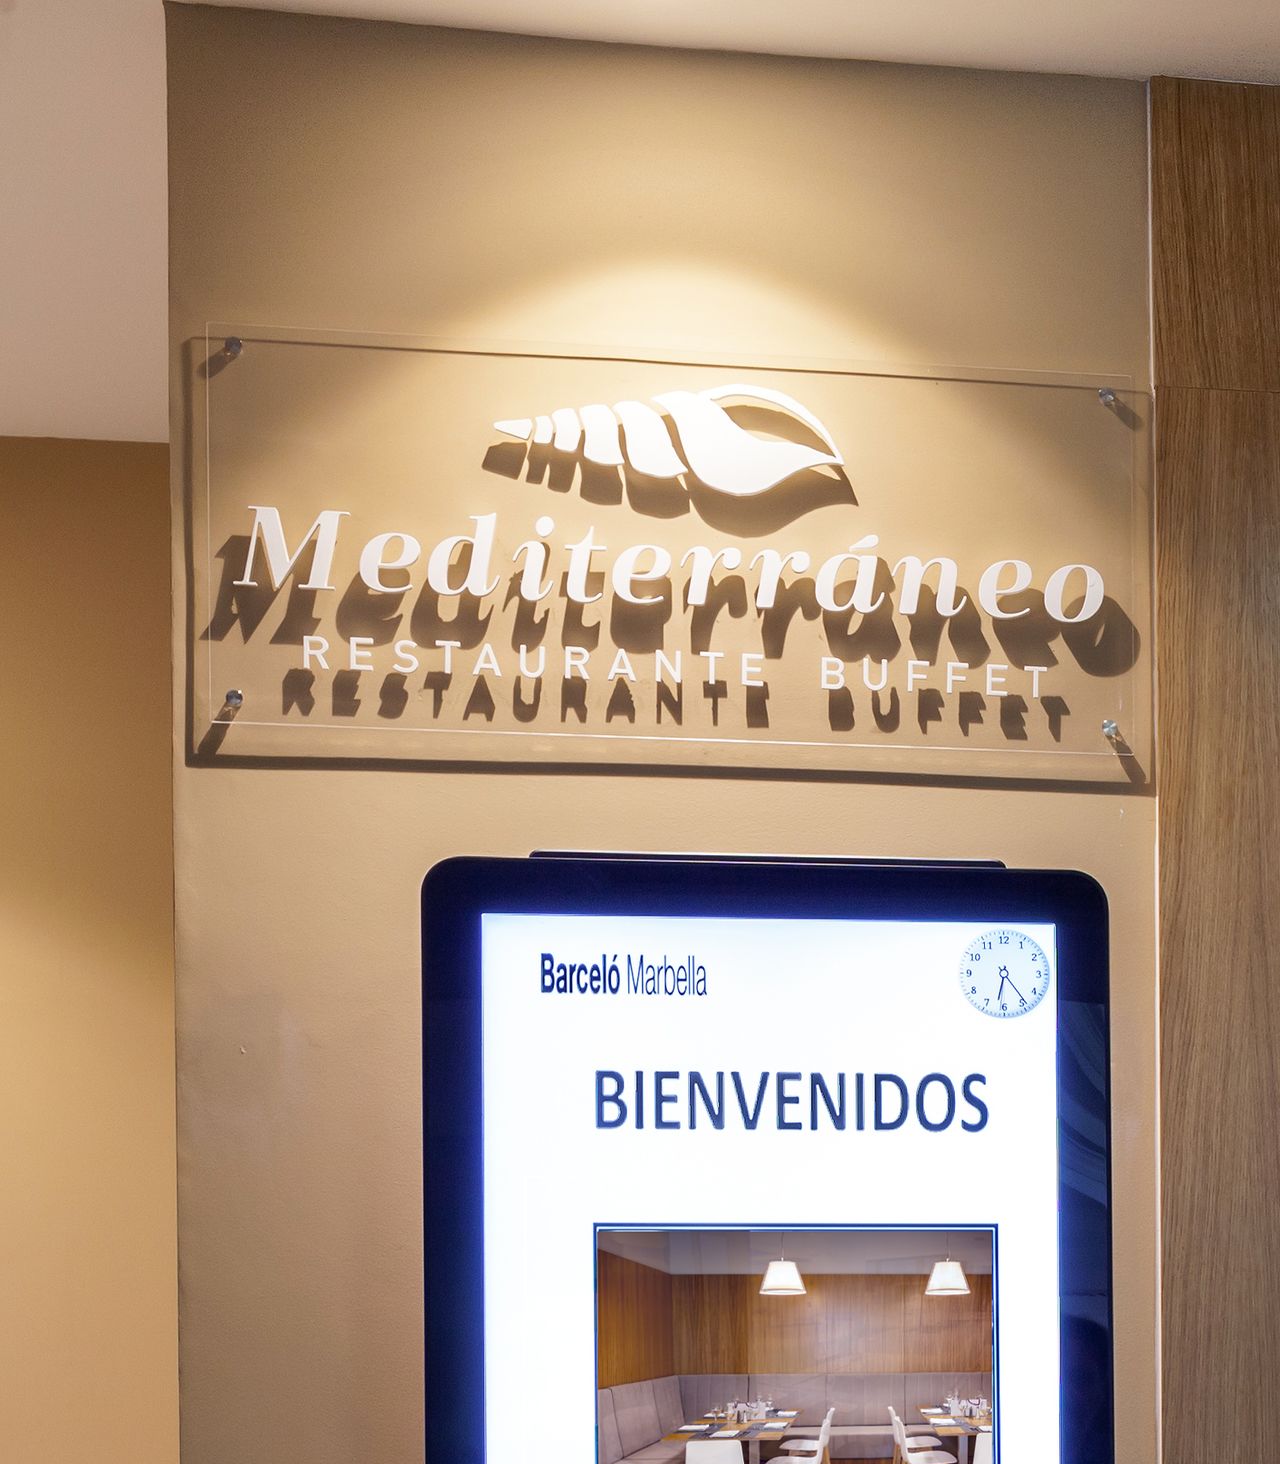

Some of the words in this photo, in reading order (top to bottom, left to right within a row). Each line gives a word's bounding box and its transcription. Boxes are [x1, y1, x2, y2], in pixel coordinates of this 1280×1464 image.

[232, 505, 1105, 623] Mediterráneo
[302, 635, 765, 687] RESTAURANTE
[820, 656, 1048, 699] BUFFET
[999, 936, 1009, 944] 12
[983, 942, 992, 950] 11
[1019, 941, 1023, 949] 1
[970, 953, 981, 961] 10
[1031, 953, 1037, 961] 2
[540, 952, 621, 995] Barceló
[627, 954, 708, 997] Marbella
[966, 969, 972, 977] 9
[1036, 970, 1042, 978] 3
[971, 986, 976, 994] 8
[1031, 987, 1036, 995] 4
[984, 998, 989, 1006] 7
[1002, 1003, 1007, 1011] 6
[595, 1070, 989, 1133] BIENVENIDOS
